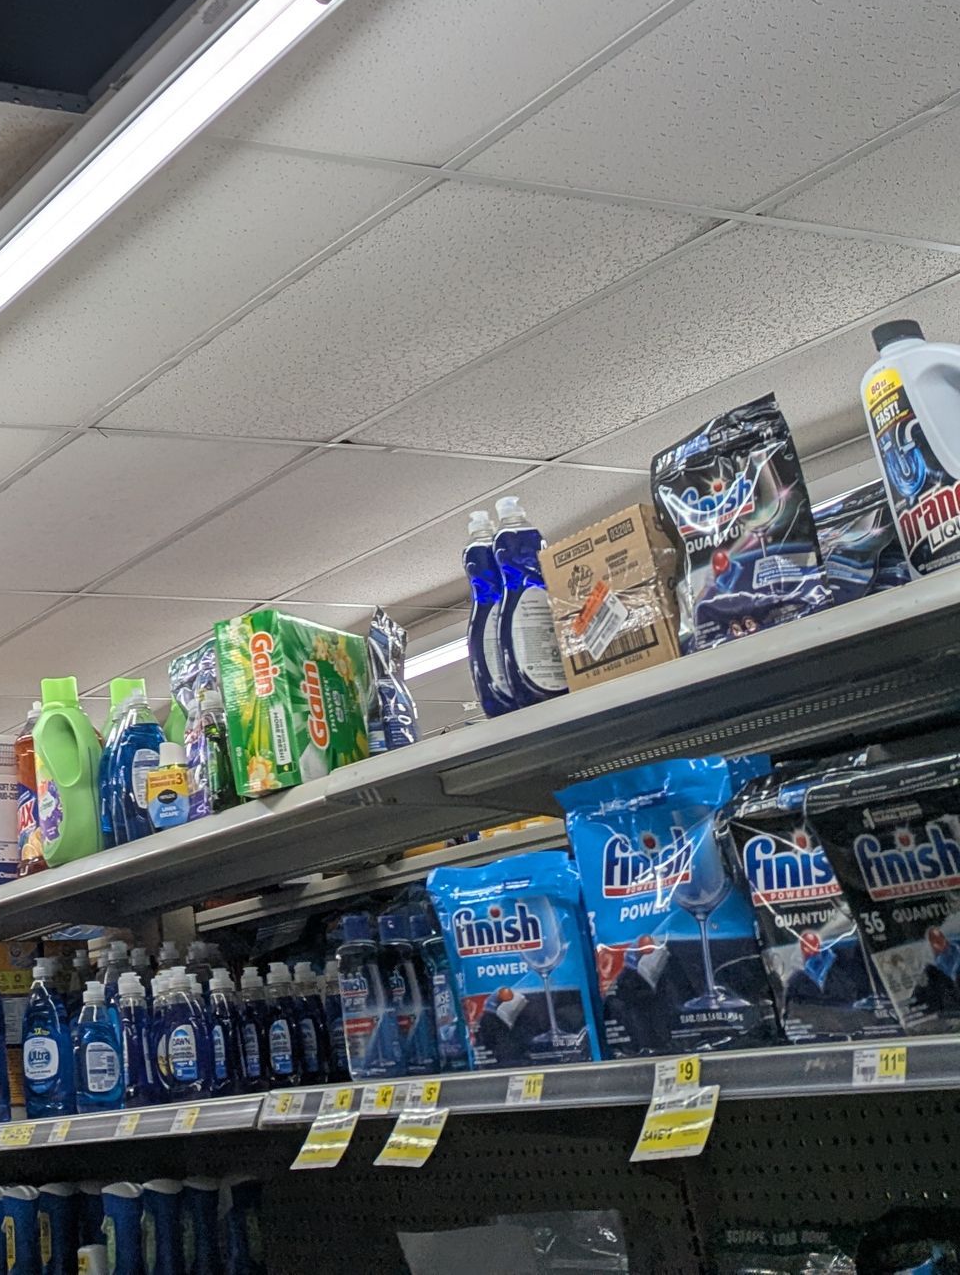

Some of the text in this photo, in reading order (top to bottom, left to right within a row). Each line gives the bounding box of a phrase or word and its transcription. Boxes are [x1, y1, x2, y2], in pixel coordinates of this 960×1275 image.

[875, 401, 900, 430] FAST!
[677, 473, 755, 526] finish
[250, 632, 280, 697] Gain
[300, 660, 330, 749] Gain
[603, 826, 693, 888] finish
[744, 828, 837, 891] finis
[854, 826, 960, 890] finish
[771, 885, 839, 901] POWERBALL
[453, 903, 541, 948] finish
[775, 908, 837, 927] QUANTUM
[860, 912, 885, 935] 36
[477, 962, 530, 978] POWER
[28, 1050, 49, 1062] Ultra
